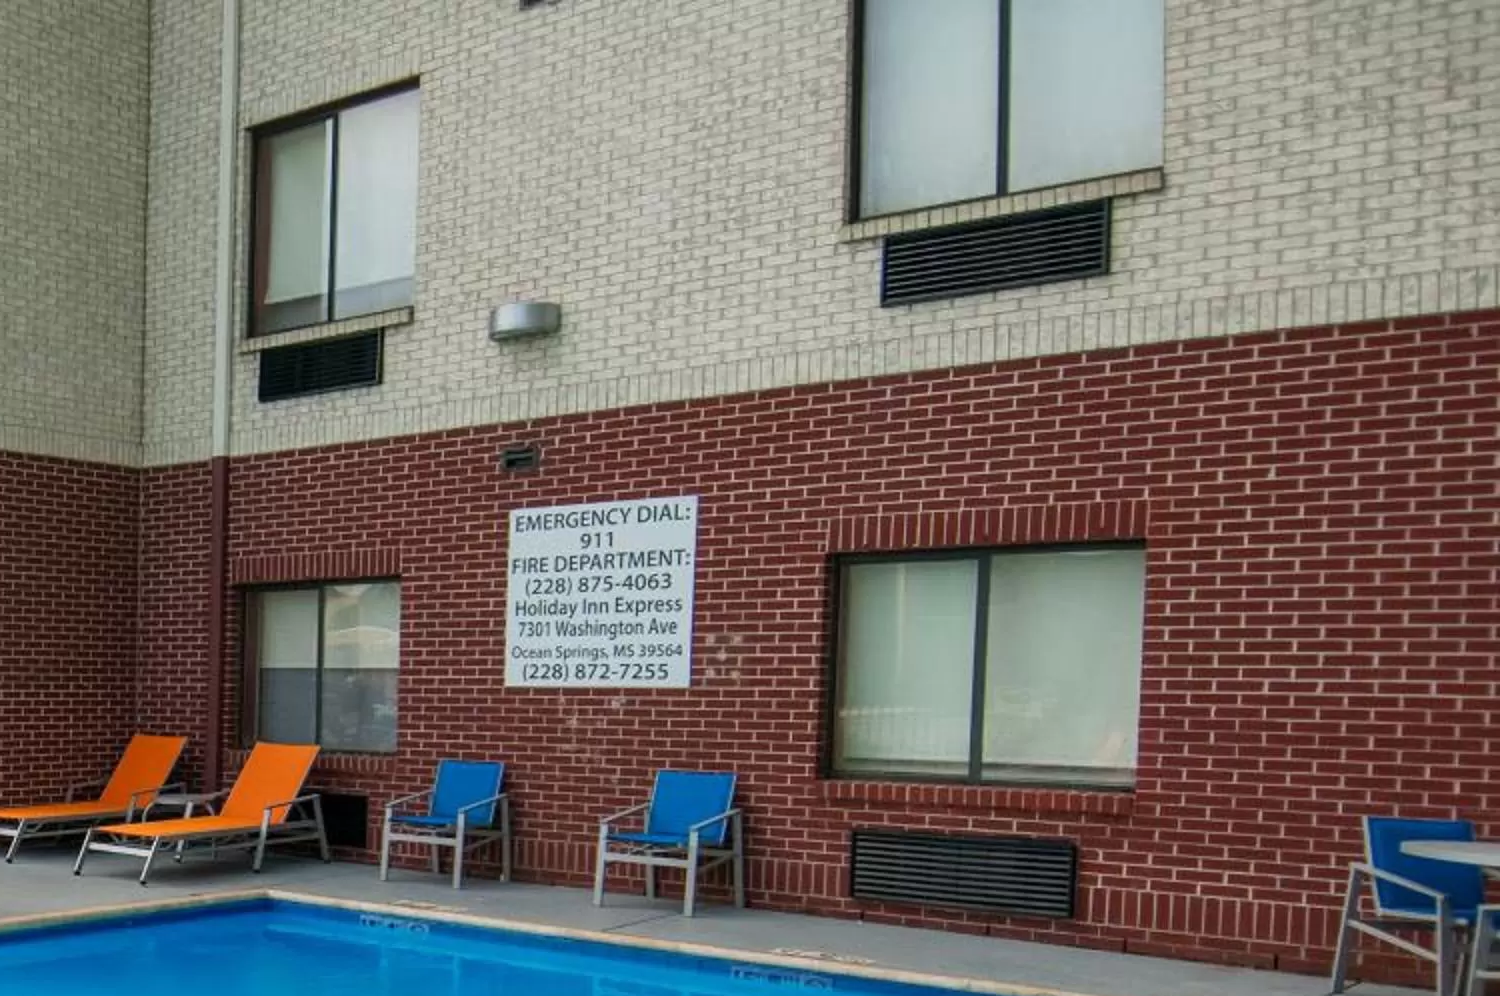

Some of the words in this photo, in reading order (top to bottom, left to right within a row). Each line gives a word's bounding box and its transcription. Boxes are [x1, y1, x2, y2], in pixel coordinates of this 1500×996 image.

[515, 508, 631, 532] EMERGENCY
[637, 504, 691, 524] DIAL:
[580, 532, 614, 549] 911
[512, 557, 548, 575] FIRE
[554, 549, 691, 573] DEPARTMENT:
[525, 577, 573, 597] (228)
[578, 573, 672, 593] 875-4063
[515, 600, 577, 618] Holiday
[582, 599, 609, 614] Inn
[615, 597, 683, 616] Express
[519, 622, 551, 637] 7301
[555, 620, 644, 640] Washington
[648, 618, 678, 635] Ave
[512, 646, 552, 659] Ocean
[555, 645, 609, 661] Springs,
[613, 645, 635, 657] MS
[638, 644, 683, 657] 39564
[523, 663, 569, 681] (228)
[575, 663, 669, 680] 872-7255
